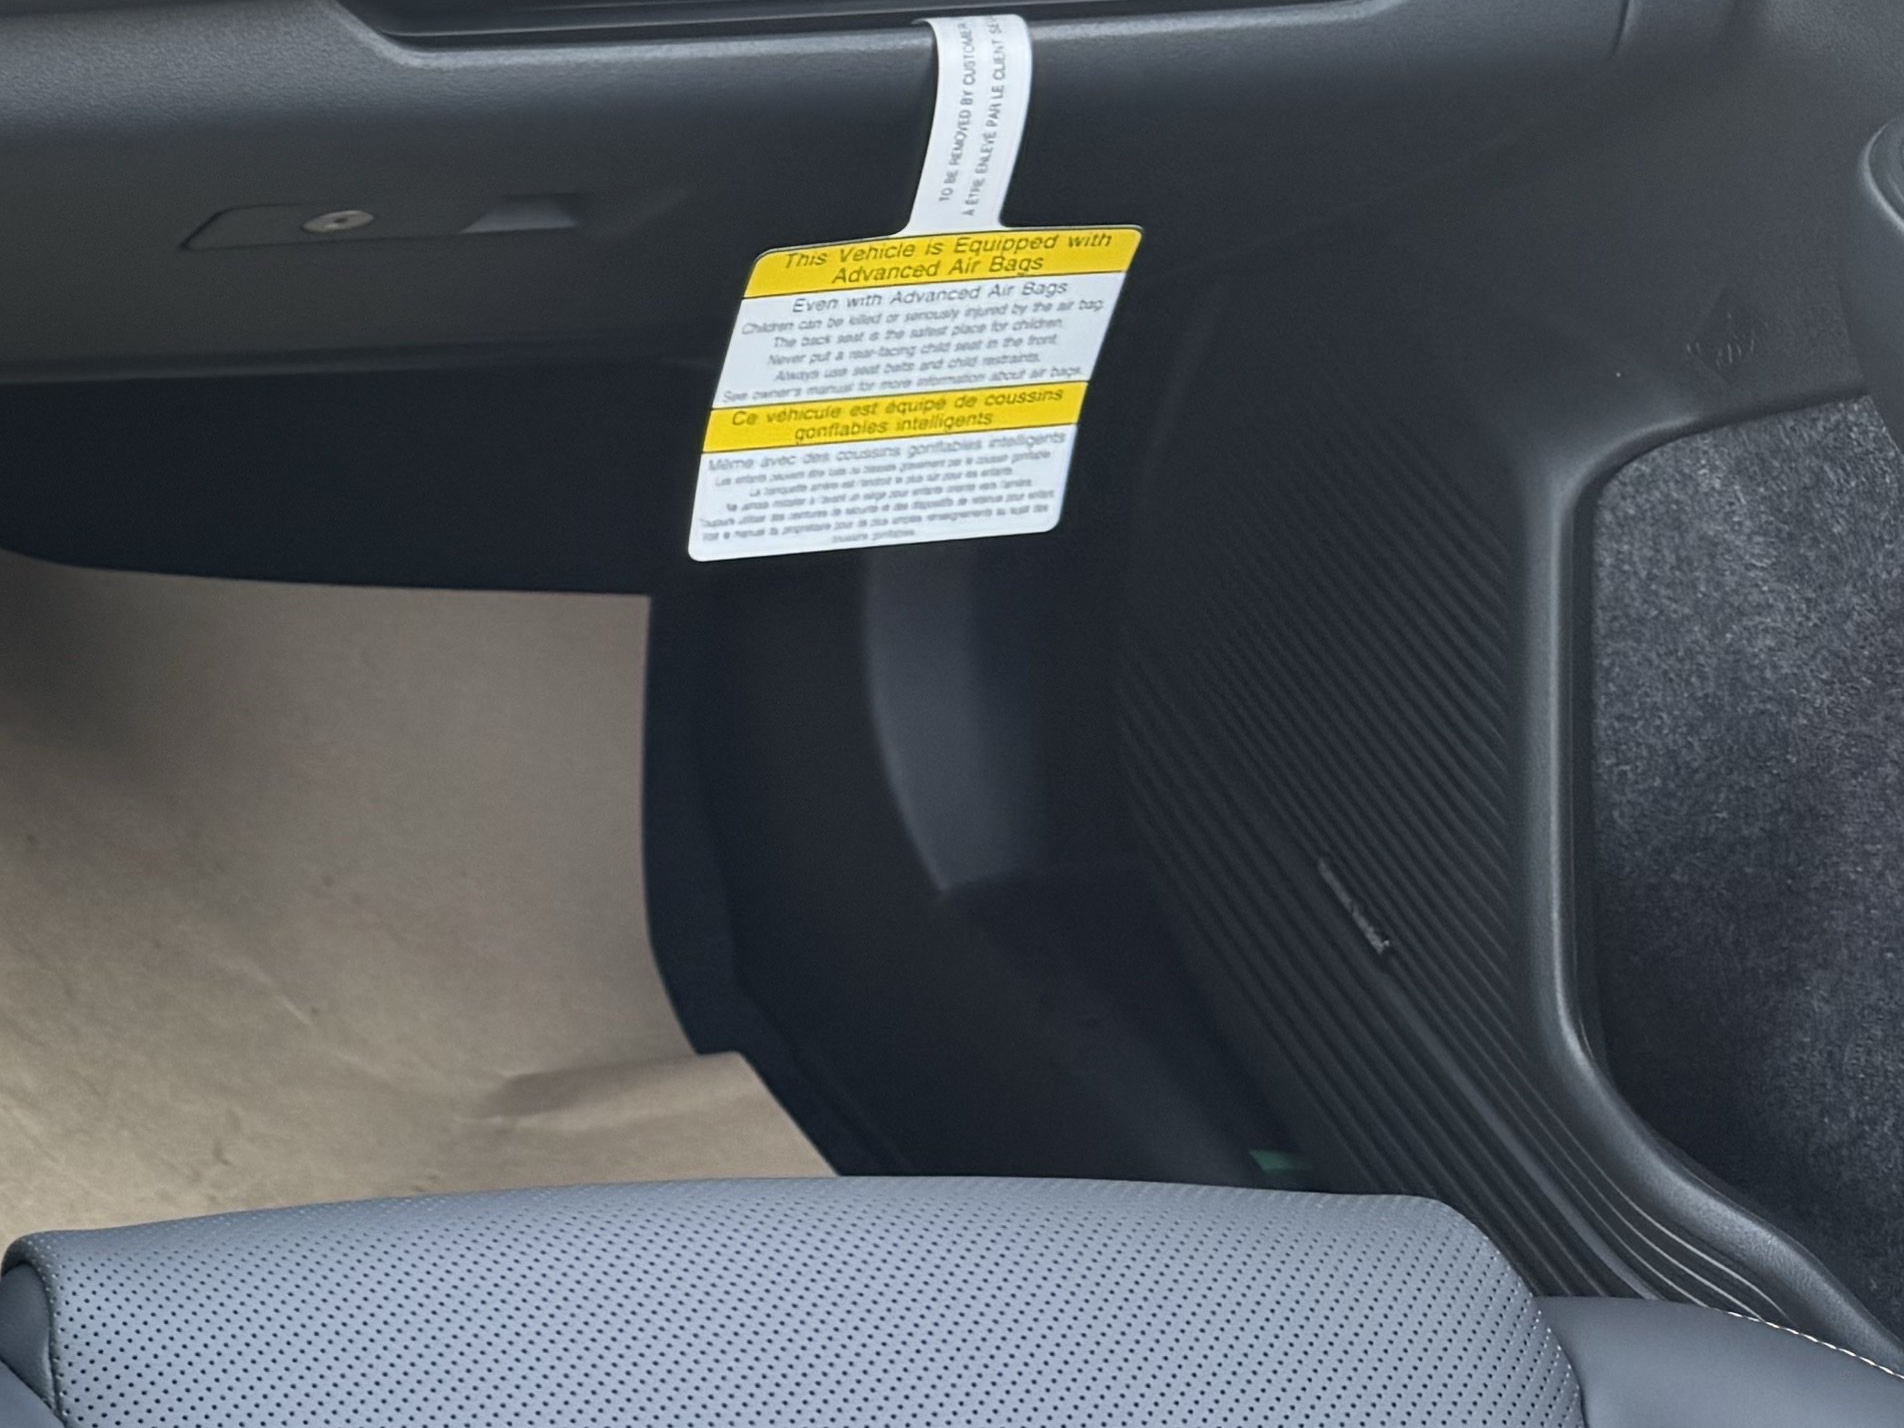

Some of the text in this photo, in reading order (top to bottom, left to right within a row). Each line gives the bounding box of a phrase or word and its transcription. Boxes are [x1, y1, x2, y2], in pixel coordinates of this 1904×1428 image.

[992, 39, 1006, 81] CLIENT
[991, 85, 1003, 99] LE
[938, 22, 976, 203] TO BE REMOVED BY CUSTOMER
[986, 103, 1002, 127] PAR
[784, 233, 1112, 269] This Vehicle is Equipped with
[832, 255, 1045, 284] Advanced Air Bags
[792, 280, 1069, 313] Even with Advanced Air Bags
[741, 321, 794, 335] Children
[798, 318, 822, 330] can
[827, 315, 844, 328] be
[848, 313, 882, 326] killed
[886, 314, 900, 324] or
[904, 307, 960, 322] seriously
[1011, 302, 1027, 316] by
[1032, 300, 1052, 312] the
[1056, 300, 1074, 311] air
[774, 335, 797, 348] The
[801, 333, 831, 346] back
[837, 332, 864, 345] seat
[884, 328, 905, 341] the
[909, 326, 948, 340] safest
[732, 388, 1064, 426] Ce véhicule est équipé de coussins
[795, 411, 994, 445] gonflables intelligents
[760, 454, 797, 468] avec
[835, 445, 901, 461] coussins
[907, 439, 982, 458] gonflables
[988, 431, 1066, 451] intelligents
